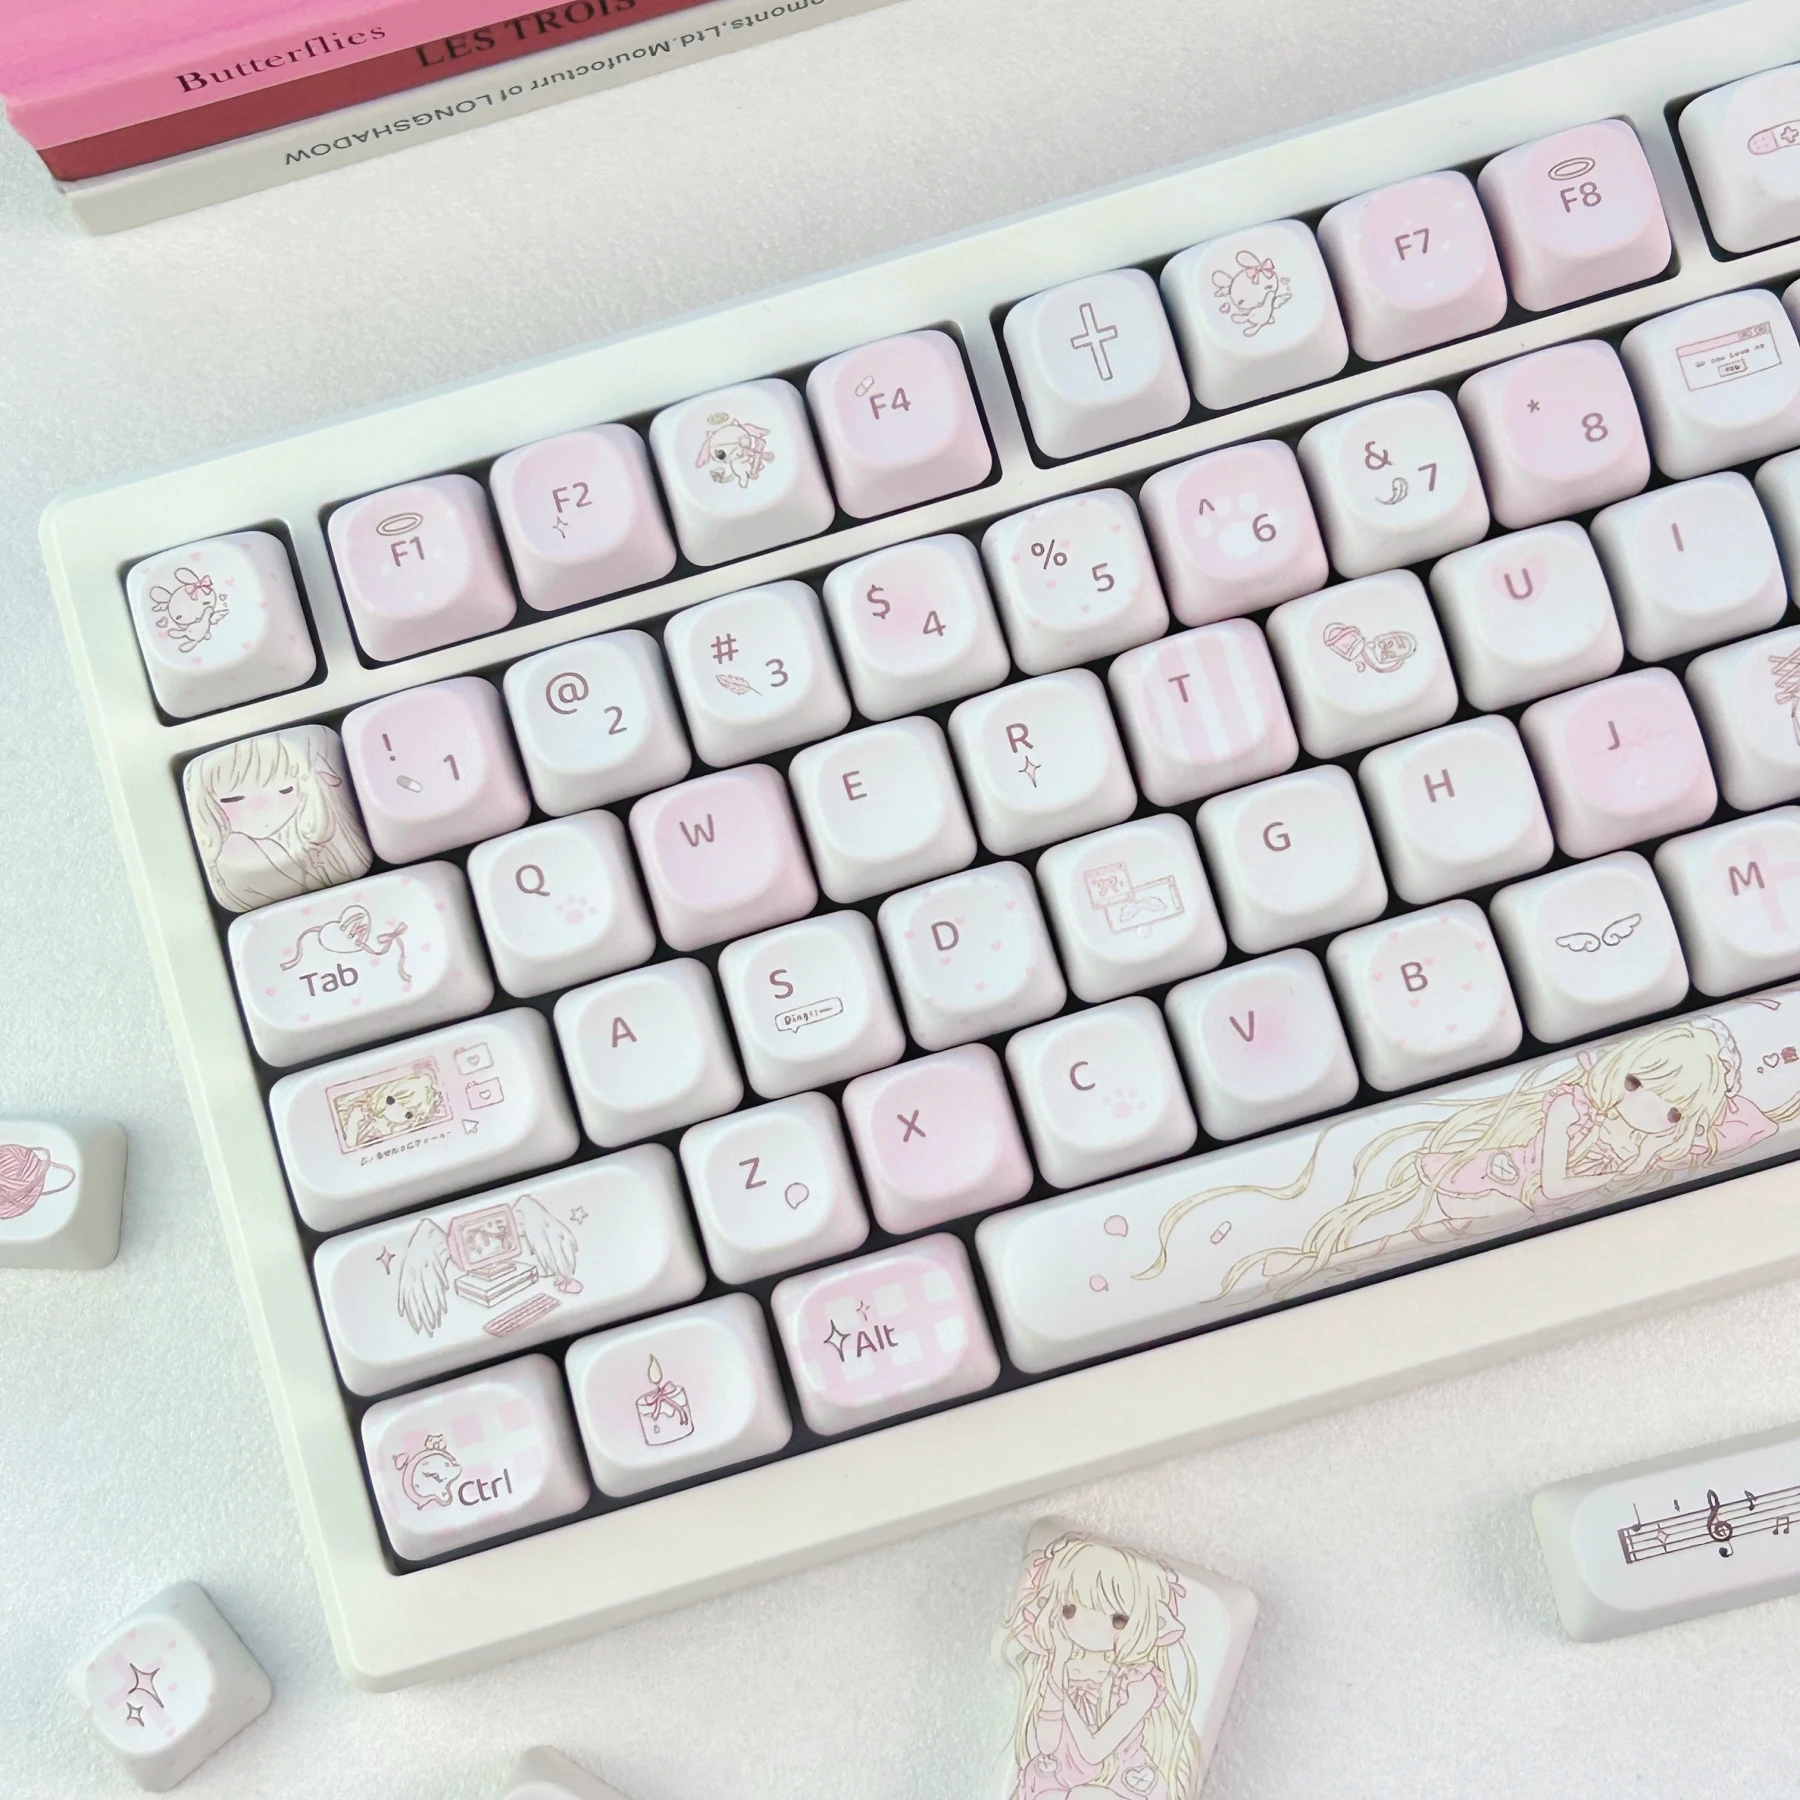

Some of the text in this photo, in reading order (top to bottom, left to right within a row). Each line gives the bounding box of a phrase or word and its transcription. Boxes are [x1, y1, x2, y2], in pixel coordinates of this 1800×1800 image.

[414, 0, 637, 69] LES TROIS
[175, 24, 387, 94] Butterflies
[499, 84, 523, 102] of
[284, 94, 494, 166] LONGSHADOW
[1559, 179, 1603, 214] F8
[1394, 227, 1430, 261] F7
[869, 386, 913, 421] F4
[1581, 412, 1609, 443] 8
[1364, 440, 1393, 471] &
[1417, 462, 1438, 492] 7
[552, 481, 593, 514] F2
[1252, 513, 1277, 543] 6
[1670, 522, 1685, 552] I
[389, 534, 427, 568] F1
[1030, 538, 1068, 570] %
[1091, 562, 1115, 593] 5
[1503, 567, 1534, 601] U
[866, 583, 891, 620] $
[922, 610, 947, 637] 4
[710, 632, 739, 665] #
[765, 658, 789, 688] 3
[1167, 673, 1191, 704] T
[545, 671, 590, 715] @
[603, 705, 628, 736] 2
[1607, 720, 1621, 751] J
[381, 733, 397, 762] !
[1005, 722, 1034, 754] R
[442, 754, 460, 781] 1
[841, 770, 868, 801] E
[1423, 768, 1456, 803] H
[678, 813, 715, 848] W
[1262, 821, 1292, 852] G
[515, 863, 551, 897] Q
[1728, 861, 1766, 897] M
[930, 920, 960, 952] D
[298, 963, 359, 997] Tab
[769, 968, 794, 1000] S
[1400, 961, 1429, 993] B
[611, 1016, 638, 1048] A
[1228, 1010, 1255, 1043] V
[1069, 1060, 1096, 1092] C
[896, 1109, 927, 1143] X
[738, 1156, 767, 1190] Z
[856, 1324, 899, 1358] Alt
[457, 1468, 513, 1507] Ctrl
